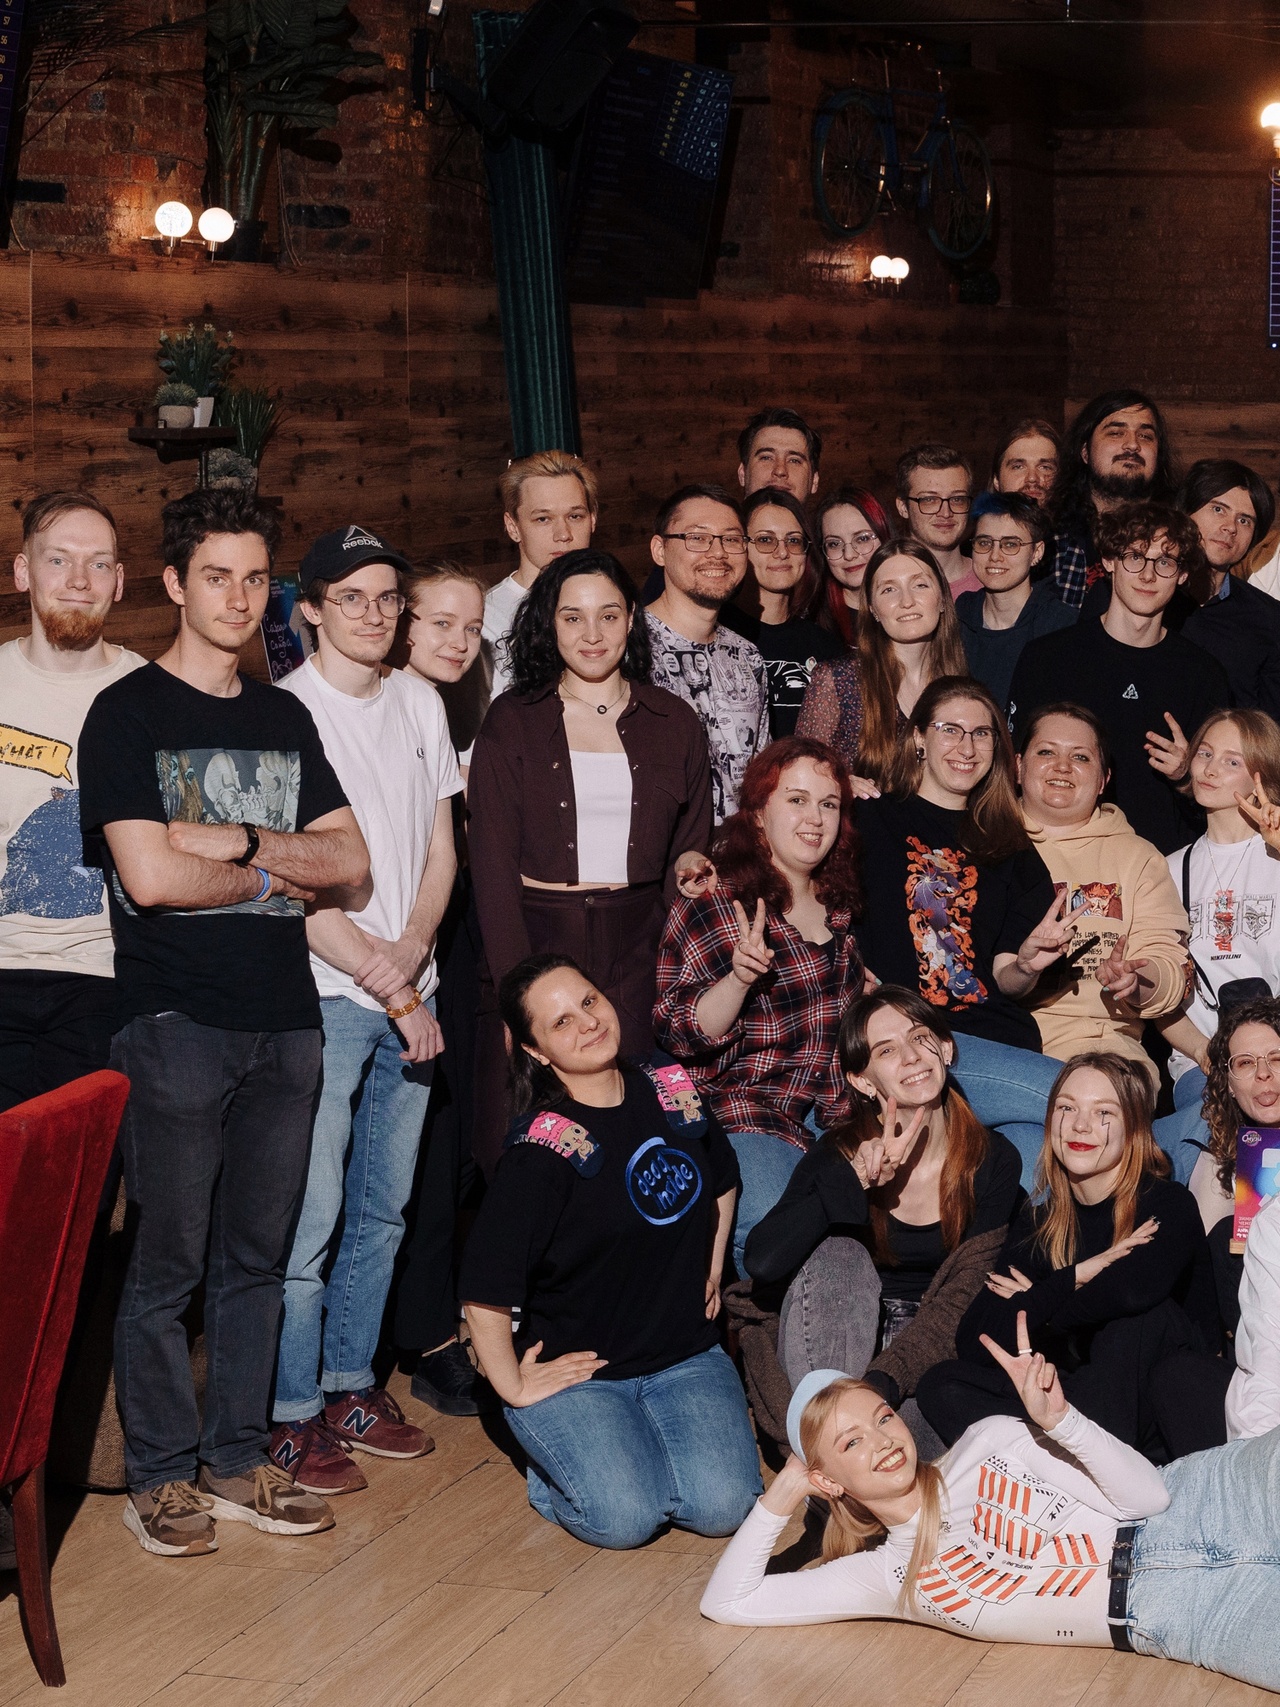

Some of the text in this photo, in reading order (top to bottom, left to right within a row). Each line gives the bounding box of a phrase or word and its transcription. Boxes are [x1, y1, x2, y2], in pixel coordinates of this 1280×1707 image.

[342, 536, 383, 551] Reebok
[634, 1151, 672, 1197] dead
[654, 1162, 693, 1215] inside
[341, 1406, 378, 1437] N
[274, 1438, 301, 1470] N
